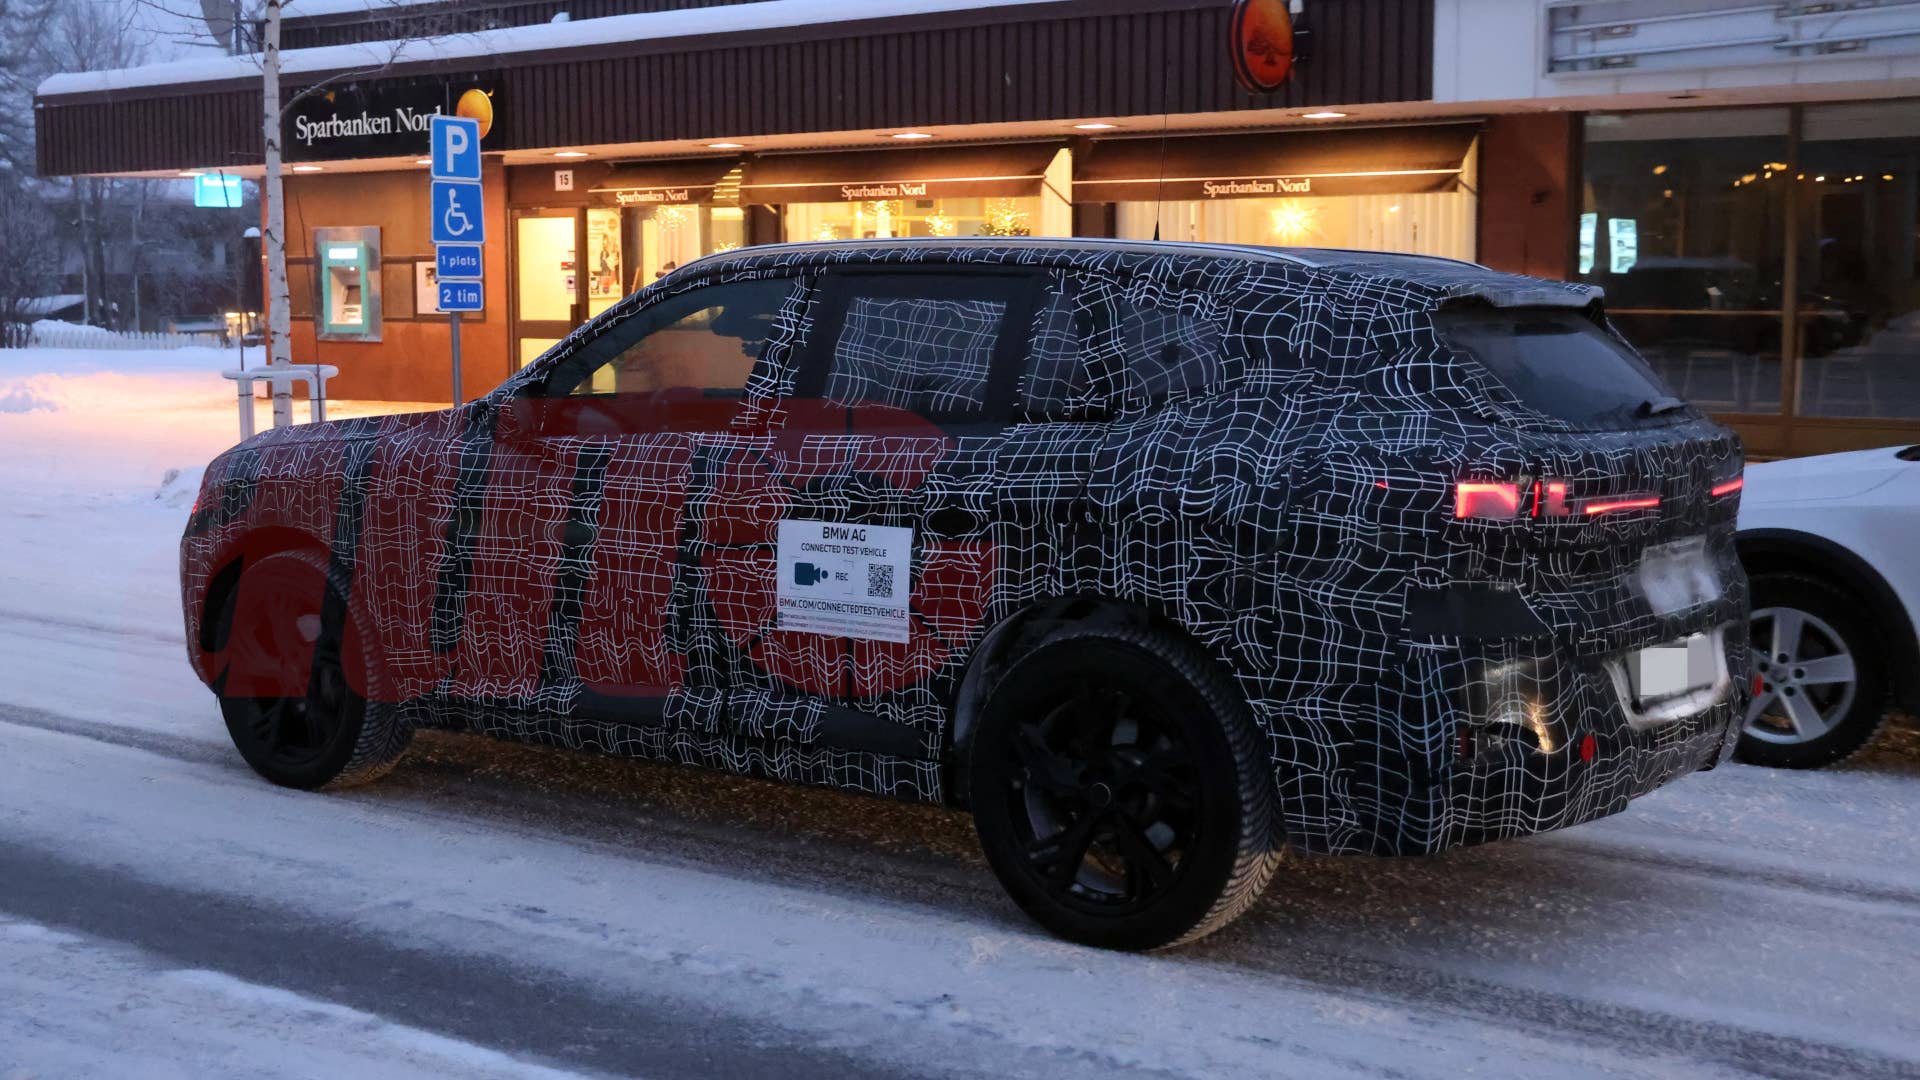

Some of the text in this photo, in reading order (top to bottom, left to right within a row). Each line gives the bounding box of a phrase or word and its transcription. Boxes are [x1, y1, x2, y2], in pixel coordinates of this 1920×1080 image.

[296, 111, 392, 146] Sparbanken
[445, 125, 469, 172] P
[559, 174, 569, 186] 15
[1203, 178, 1311, 198] Sparbanken Nord
[616, 189, 688, 206] Sparbanken Nord
[841, 183, 926, 201] Sparbanken Nord
[442, 255, 477, 268] 1 plats
[443, 288, 478, 303] 2 tim
[822, 526, 866, 541] BMW AG
[801, 542, 887, 558] CONNECTED TEST VEHICLE
[835, 571, 849, 582] REC
[779, 598, 905, 619] BMW.COM/CONNECTEDTESTVEHICLE
